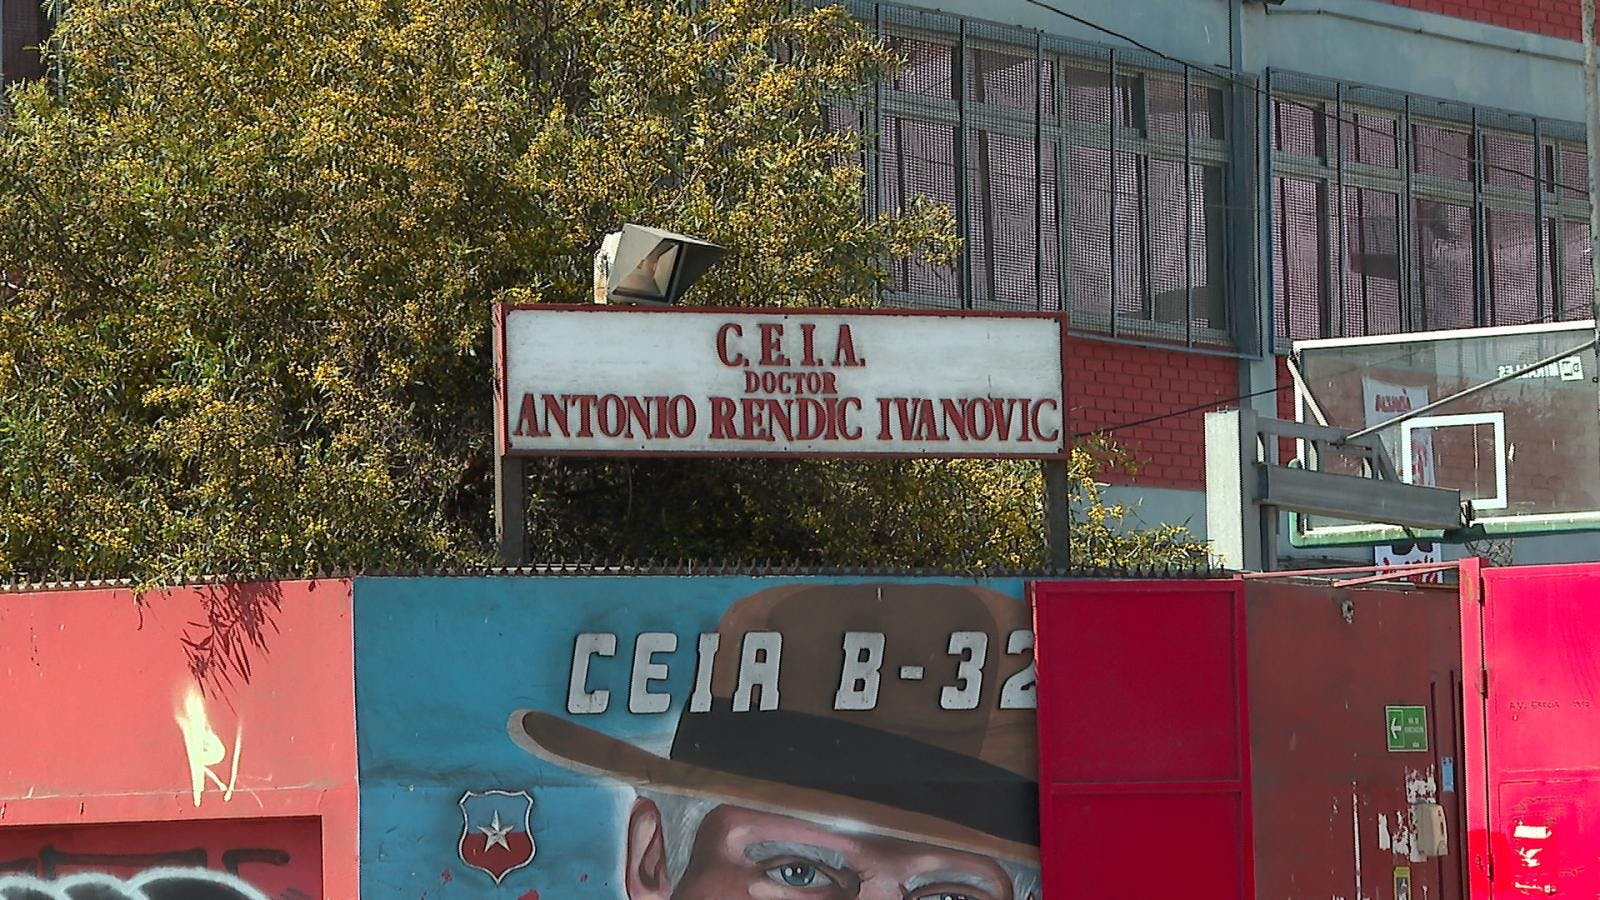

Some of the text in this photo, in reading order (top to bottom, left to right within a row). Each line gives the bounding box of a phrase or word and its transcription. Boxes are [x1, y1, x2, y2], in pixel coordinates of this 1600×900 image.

[744, 371, 837, 395] DOCTOR
[512, 393, 1060, 442] ANTONIO RENDIC IVANOVIC
[567, 631, 783, 713] CEIA
